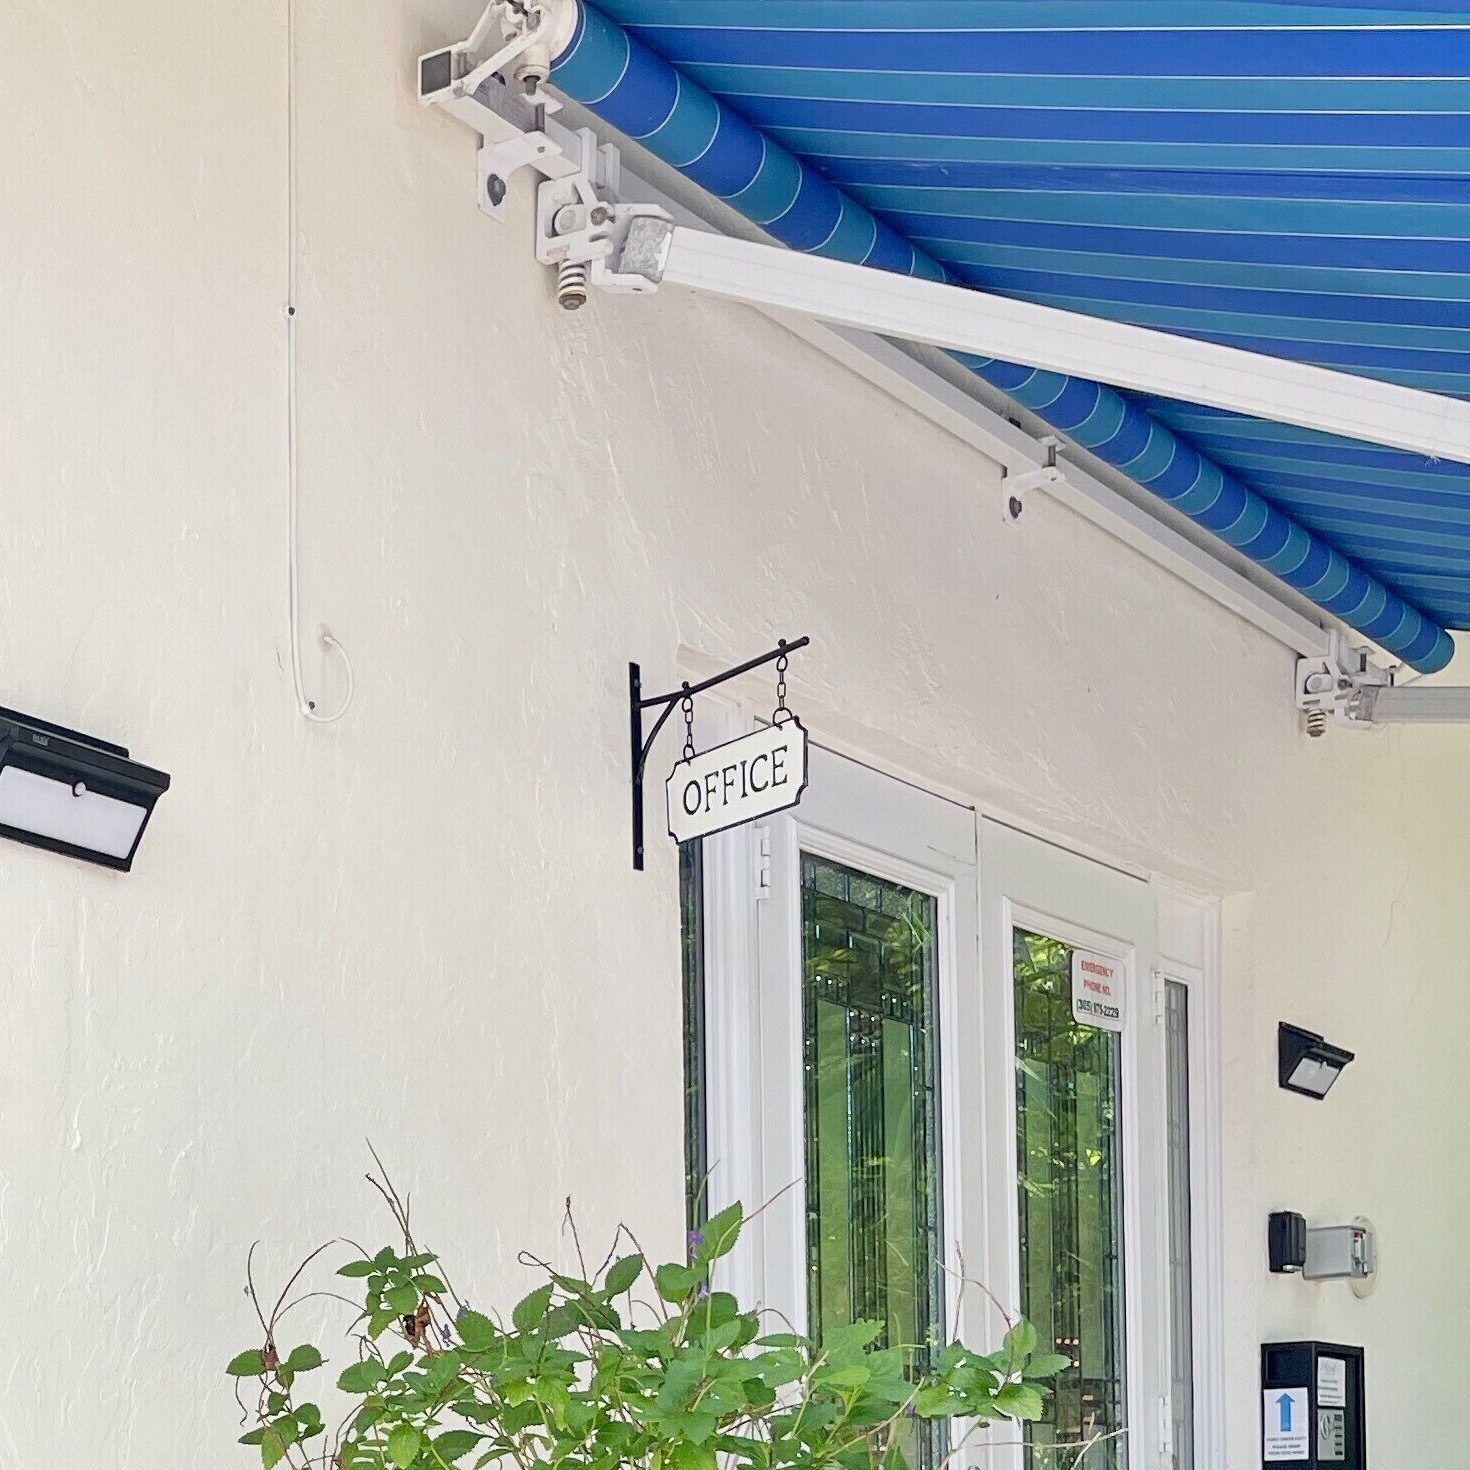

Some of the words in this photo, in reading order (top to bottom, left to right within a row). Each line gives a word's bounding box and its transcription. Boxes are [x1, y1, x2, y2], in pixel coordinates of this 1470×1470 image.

[682, 744, 789, 816] OFFICE
[1081, 960, 1114, 977] EMERGENCY
[1083, 979, 1102, 994] PHONE
[1076, 998, 1093, 1014] (305)
